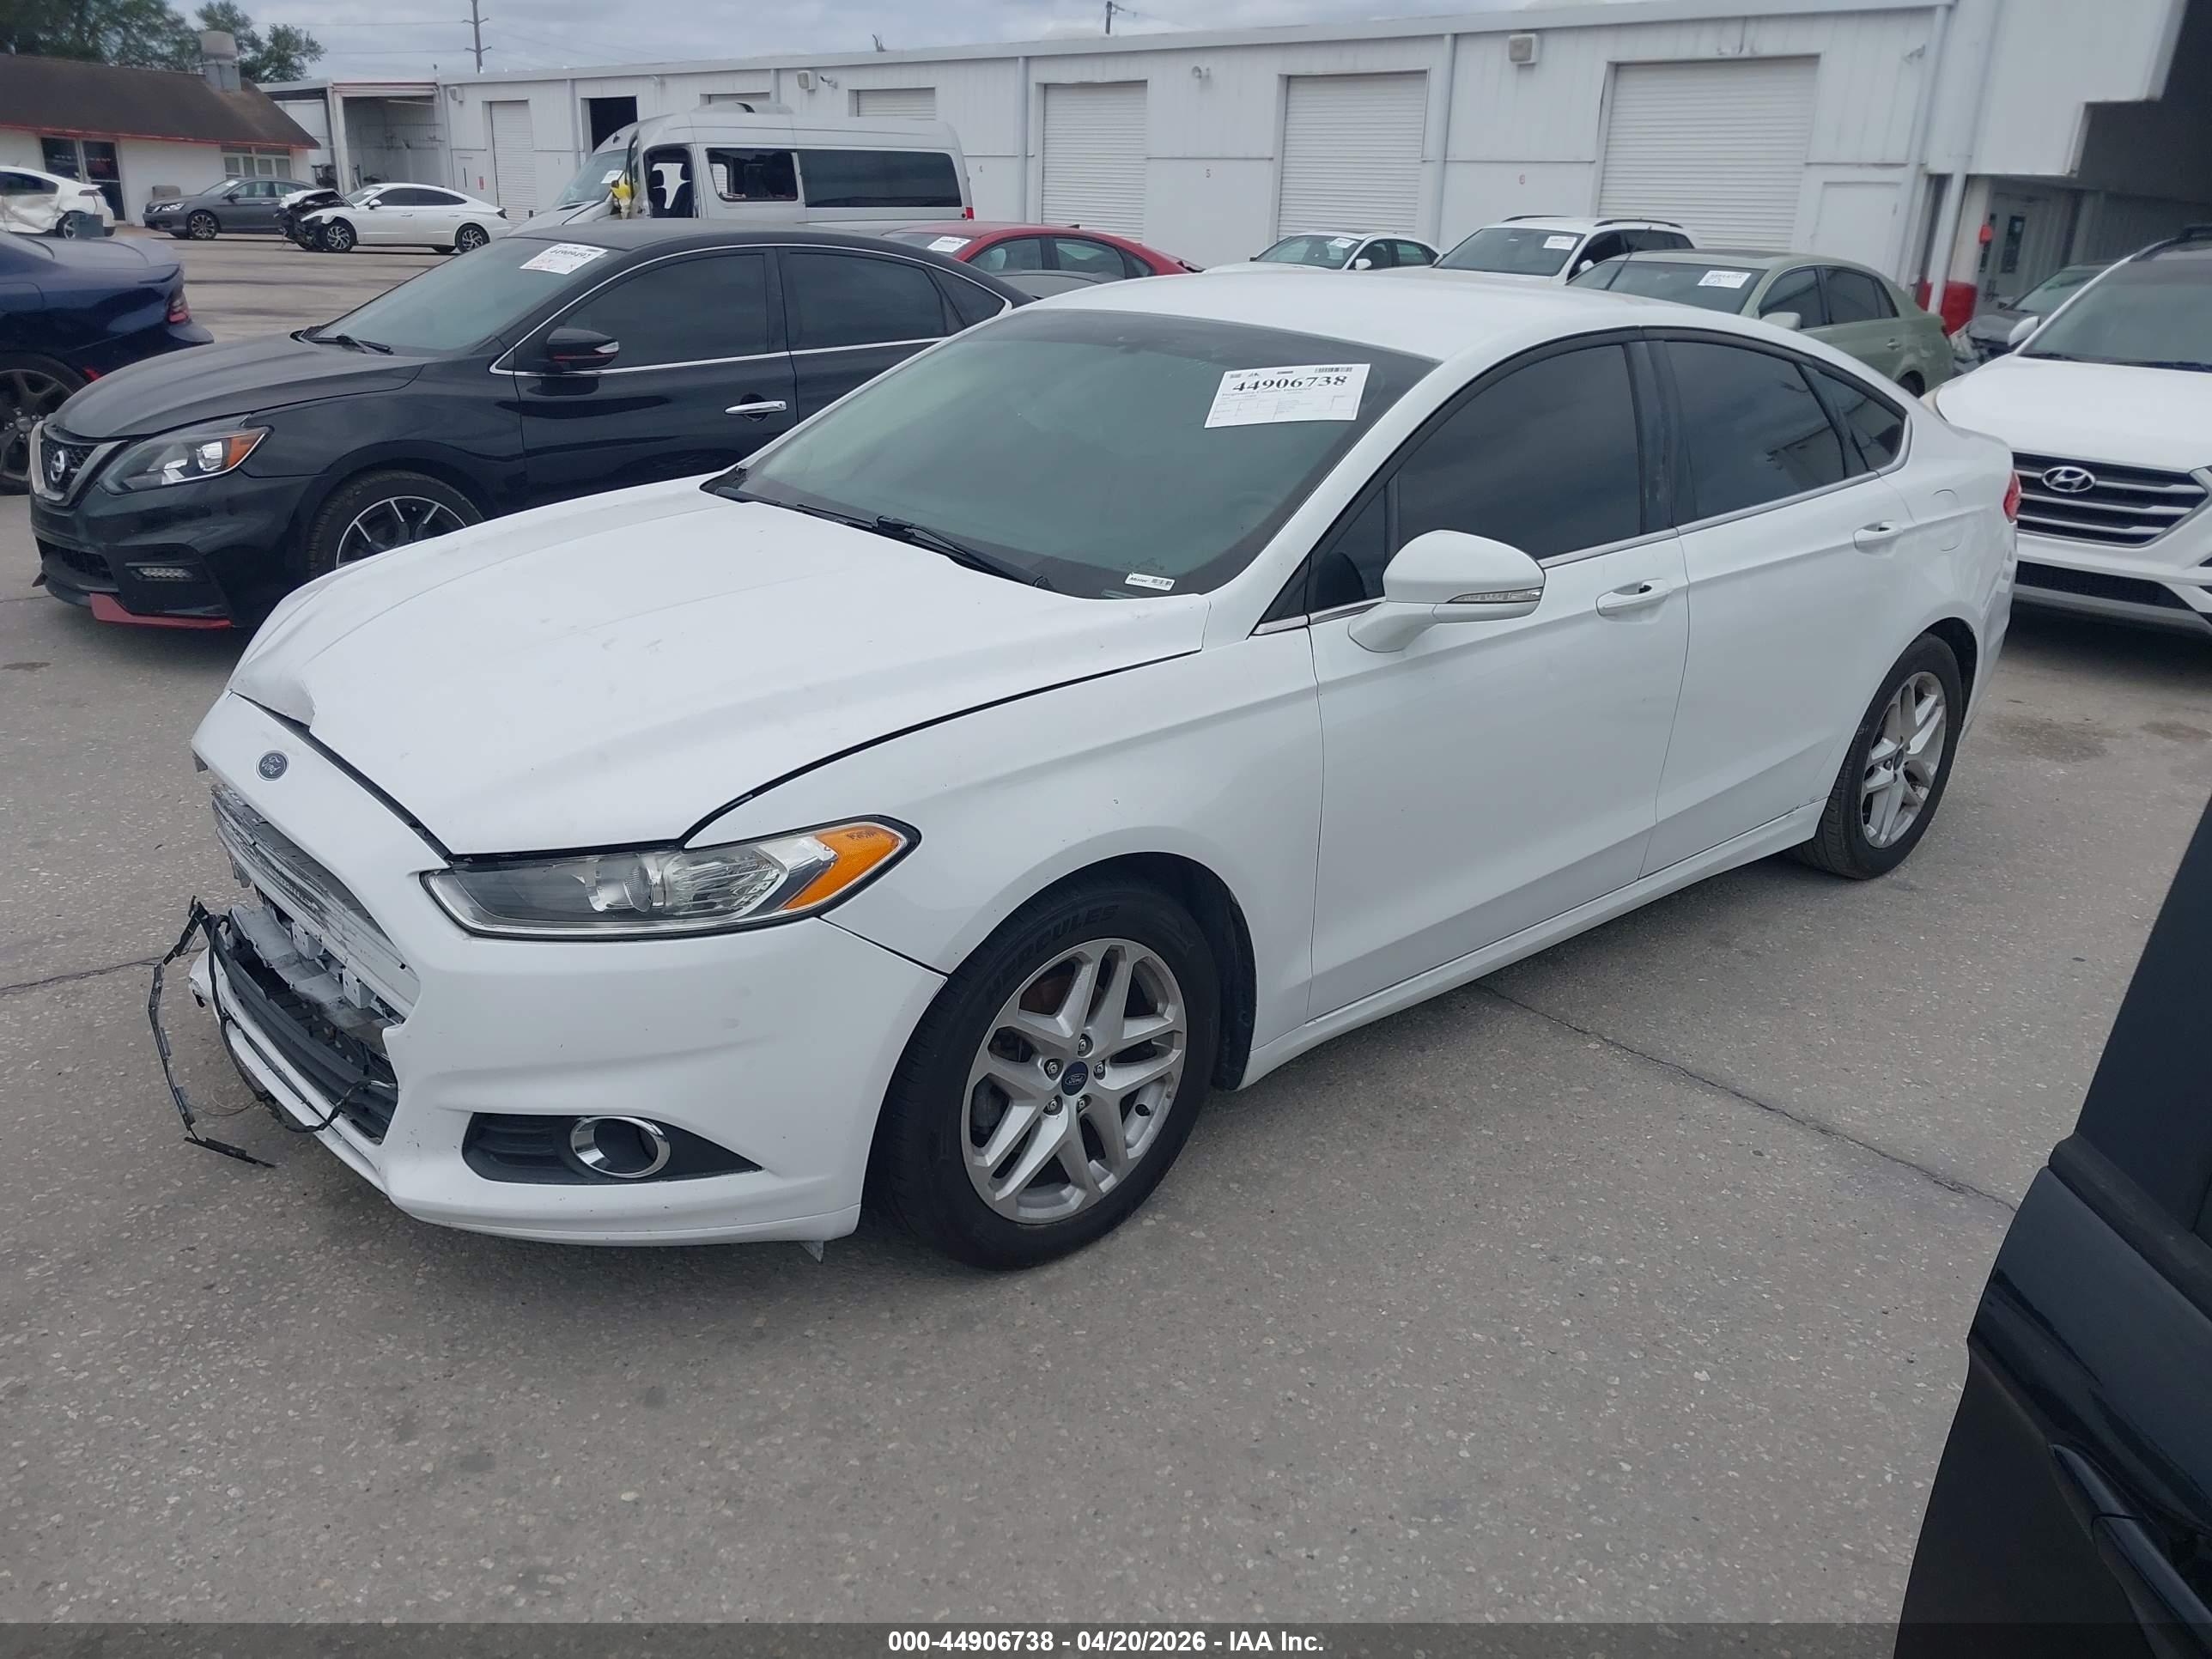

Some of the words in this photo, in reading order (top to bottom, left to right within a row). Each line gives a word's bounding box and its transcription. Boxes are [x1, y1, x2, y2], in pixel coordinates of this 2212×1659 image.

[1232, 375, 1348, 392] 44906738
[261, 756, 283, 775] Ford
[988, 905, 1120, 996] HERCULES
